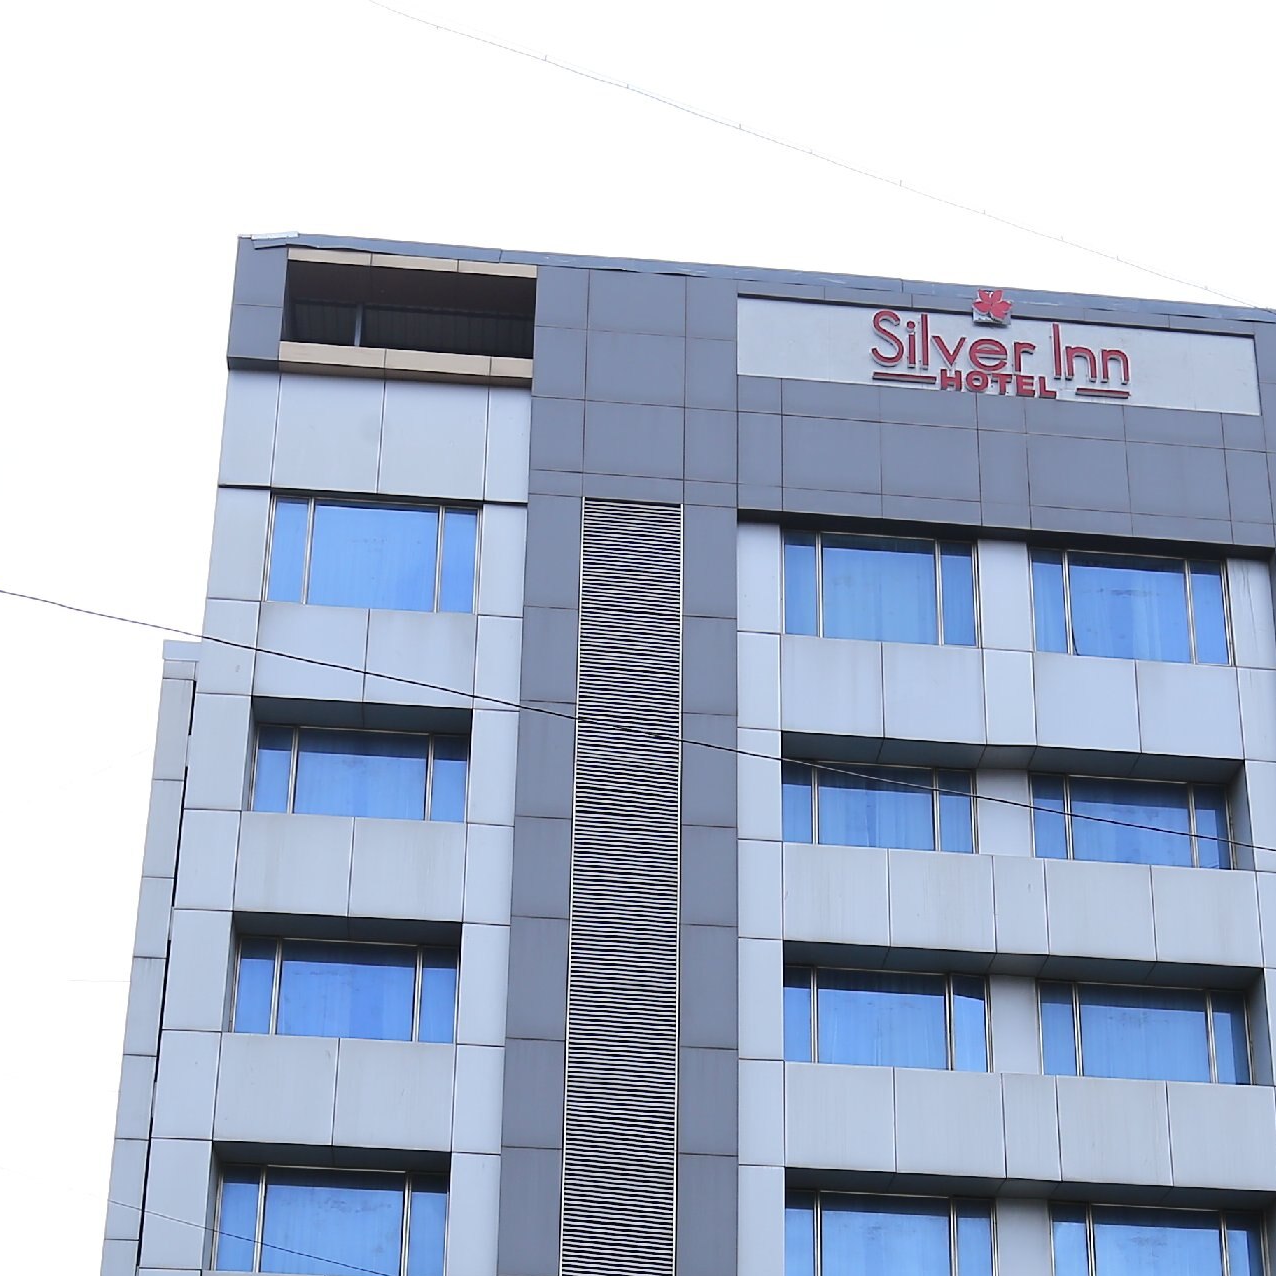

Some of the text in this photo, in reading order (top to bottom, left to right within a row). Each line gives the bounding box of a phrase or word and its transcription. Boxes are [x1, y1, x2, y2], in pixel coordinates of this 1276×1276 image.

[871, 309, 1132, 385] Silver Inn
[939, 368, 1058, 400] HOTEL
